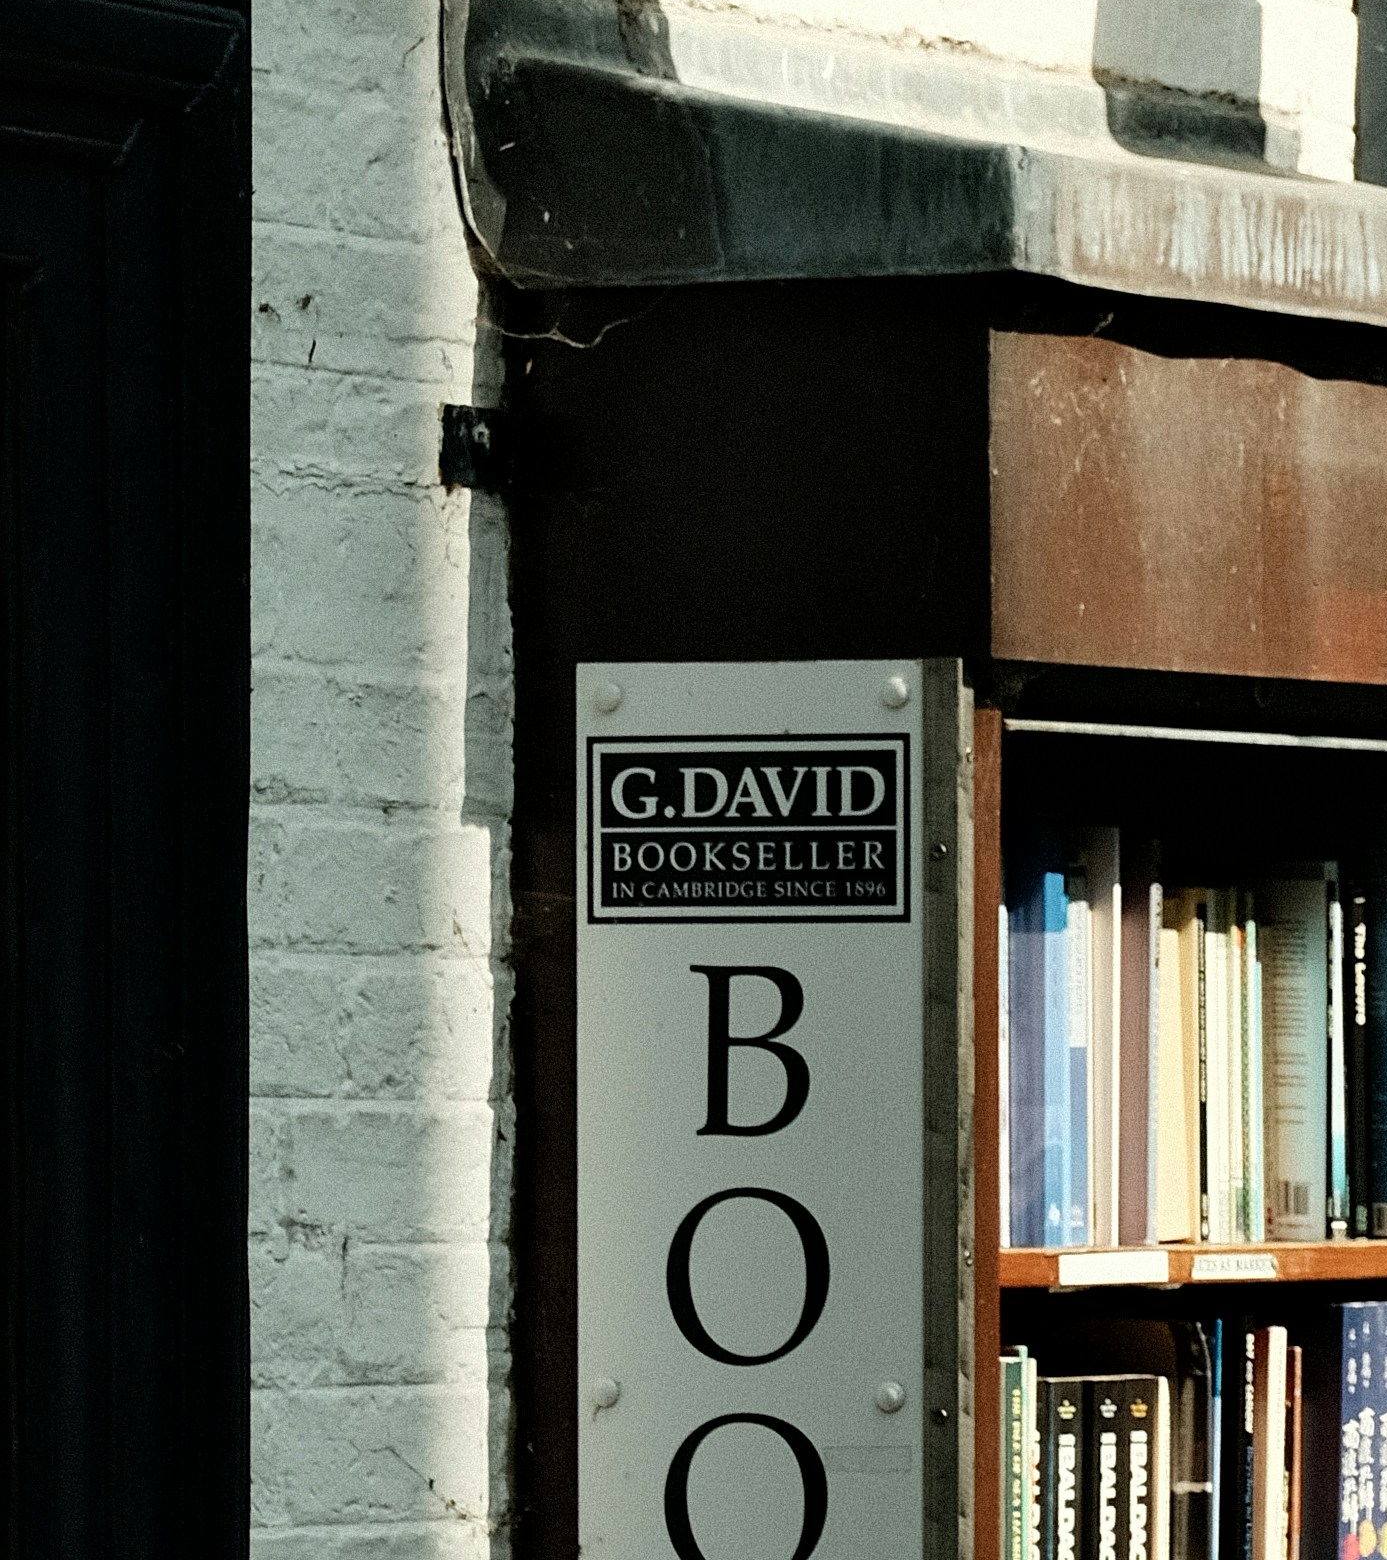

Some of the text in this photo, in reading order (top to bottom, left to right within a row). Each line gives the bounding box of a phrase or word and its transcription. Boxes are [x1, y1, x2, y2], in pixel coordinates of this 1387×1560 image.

[610, 766, 886, 820] G.DAVID
[612, 840, 886, 873] BOOKSELLER
[611, 879, 886, 899] IN CAMBRIDGE SINCE 1896
[1354, 922, 1367, 1027] The Louvre
